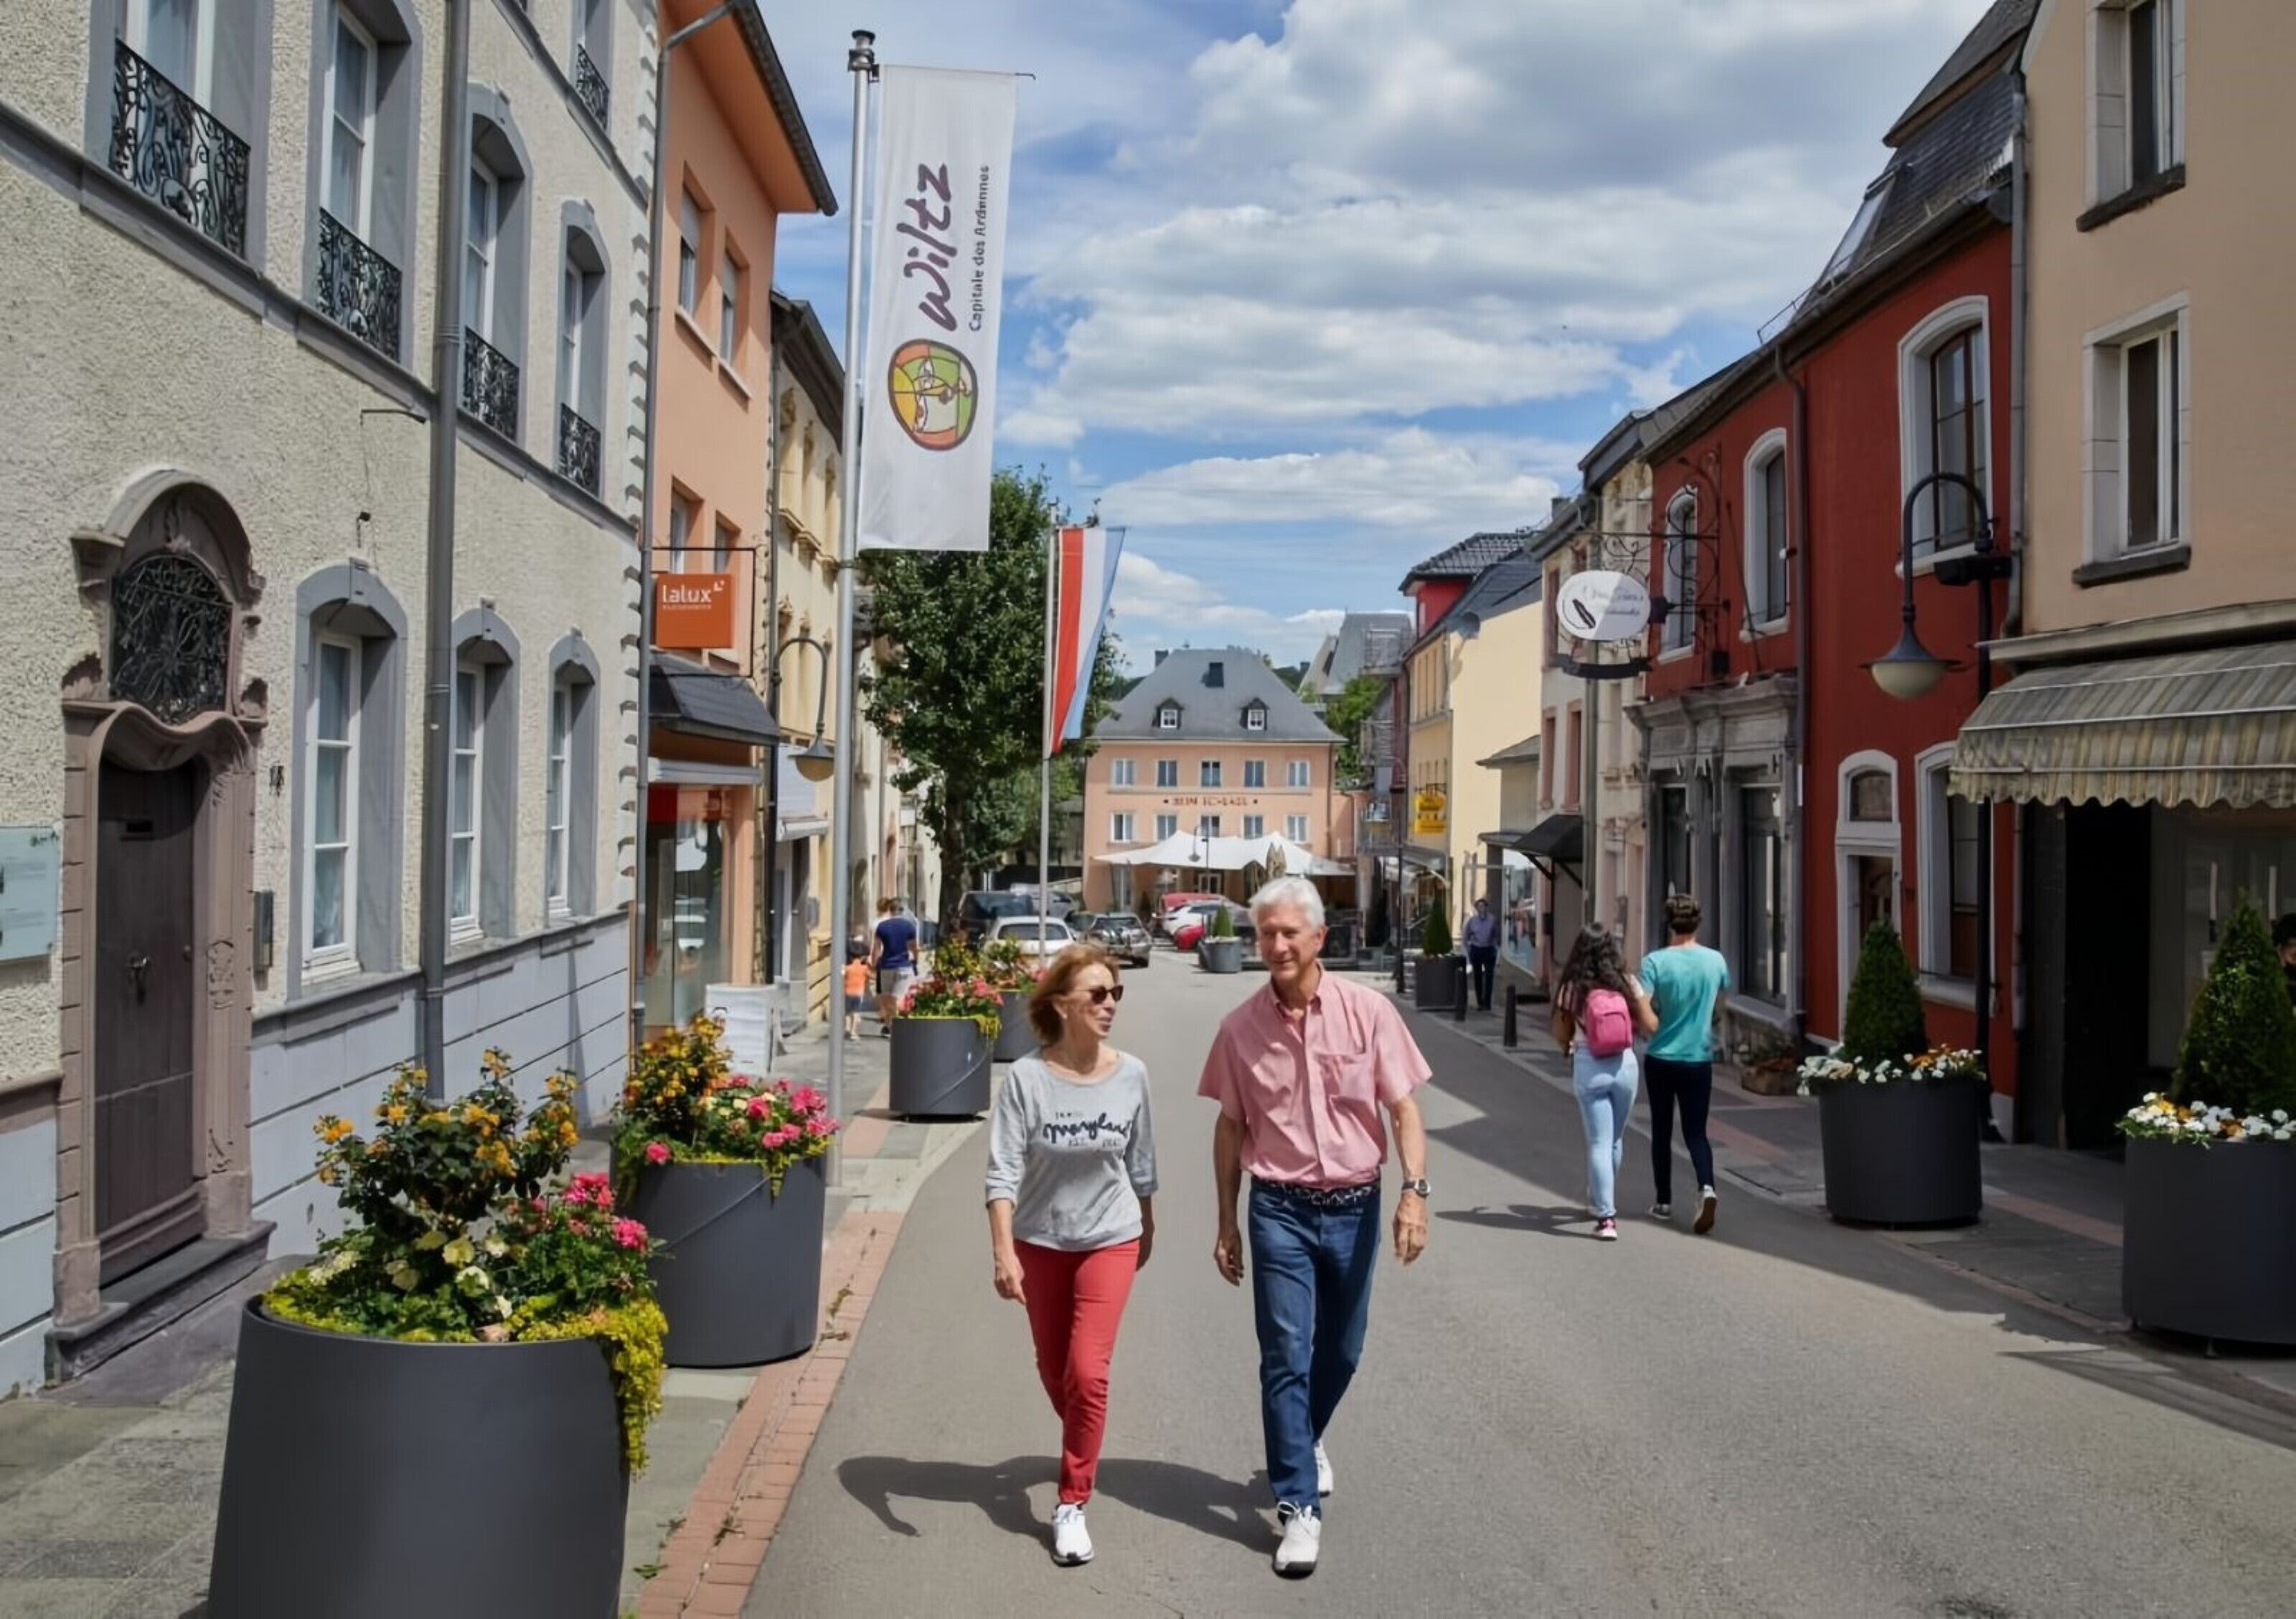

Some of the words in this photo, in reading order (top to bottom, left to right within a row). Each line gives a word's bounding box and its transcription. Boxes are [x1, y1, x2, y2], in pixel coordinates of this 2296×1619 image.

[974, 165, 989, 237] Ardennes
[969, 270, 985, 332] Capitale
[662, 584, 712, 604] lalux
